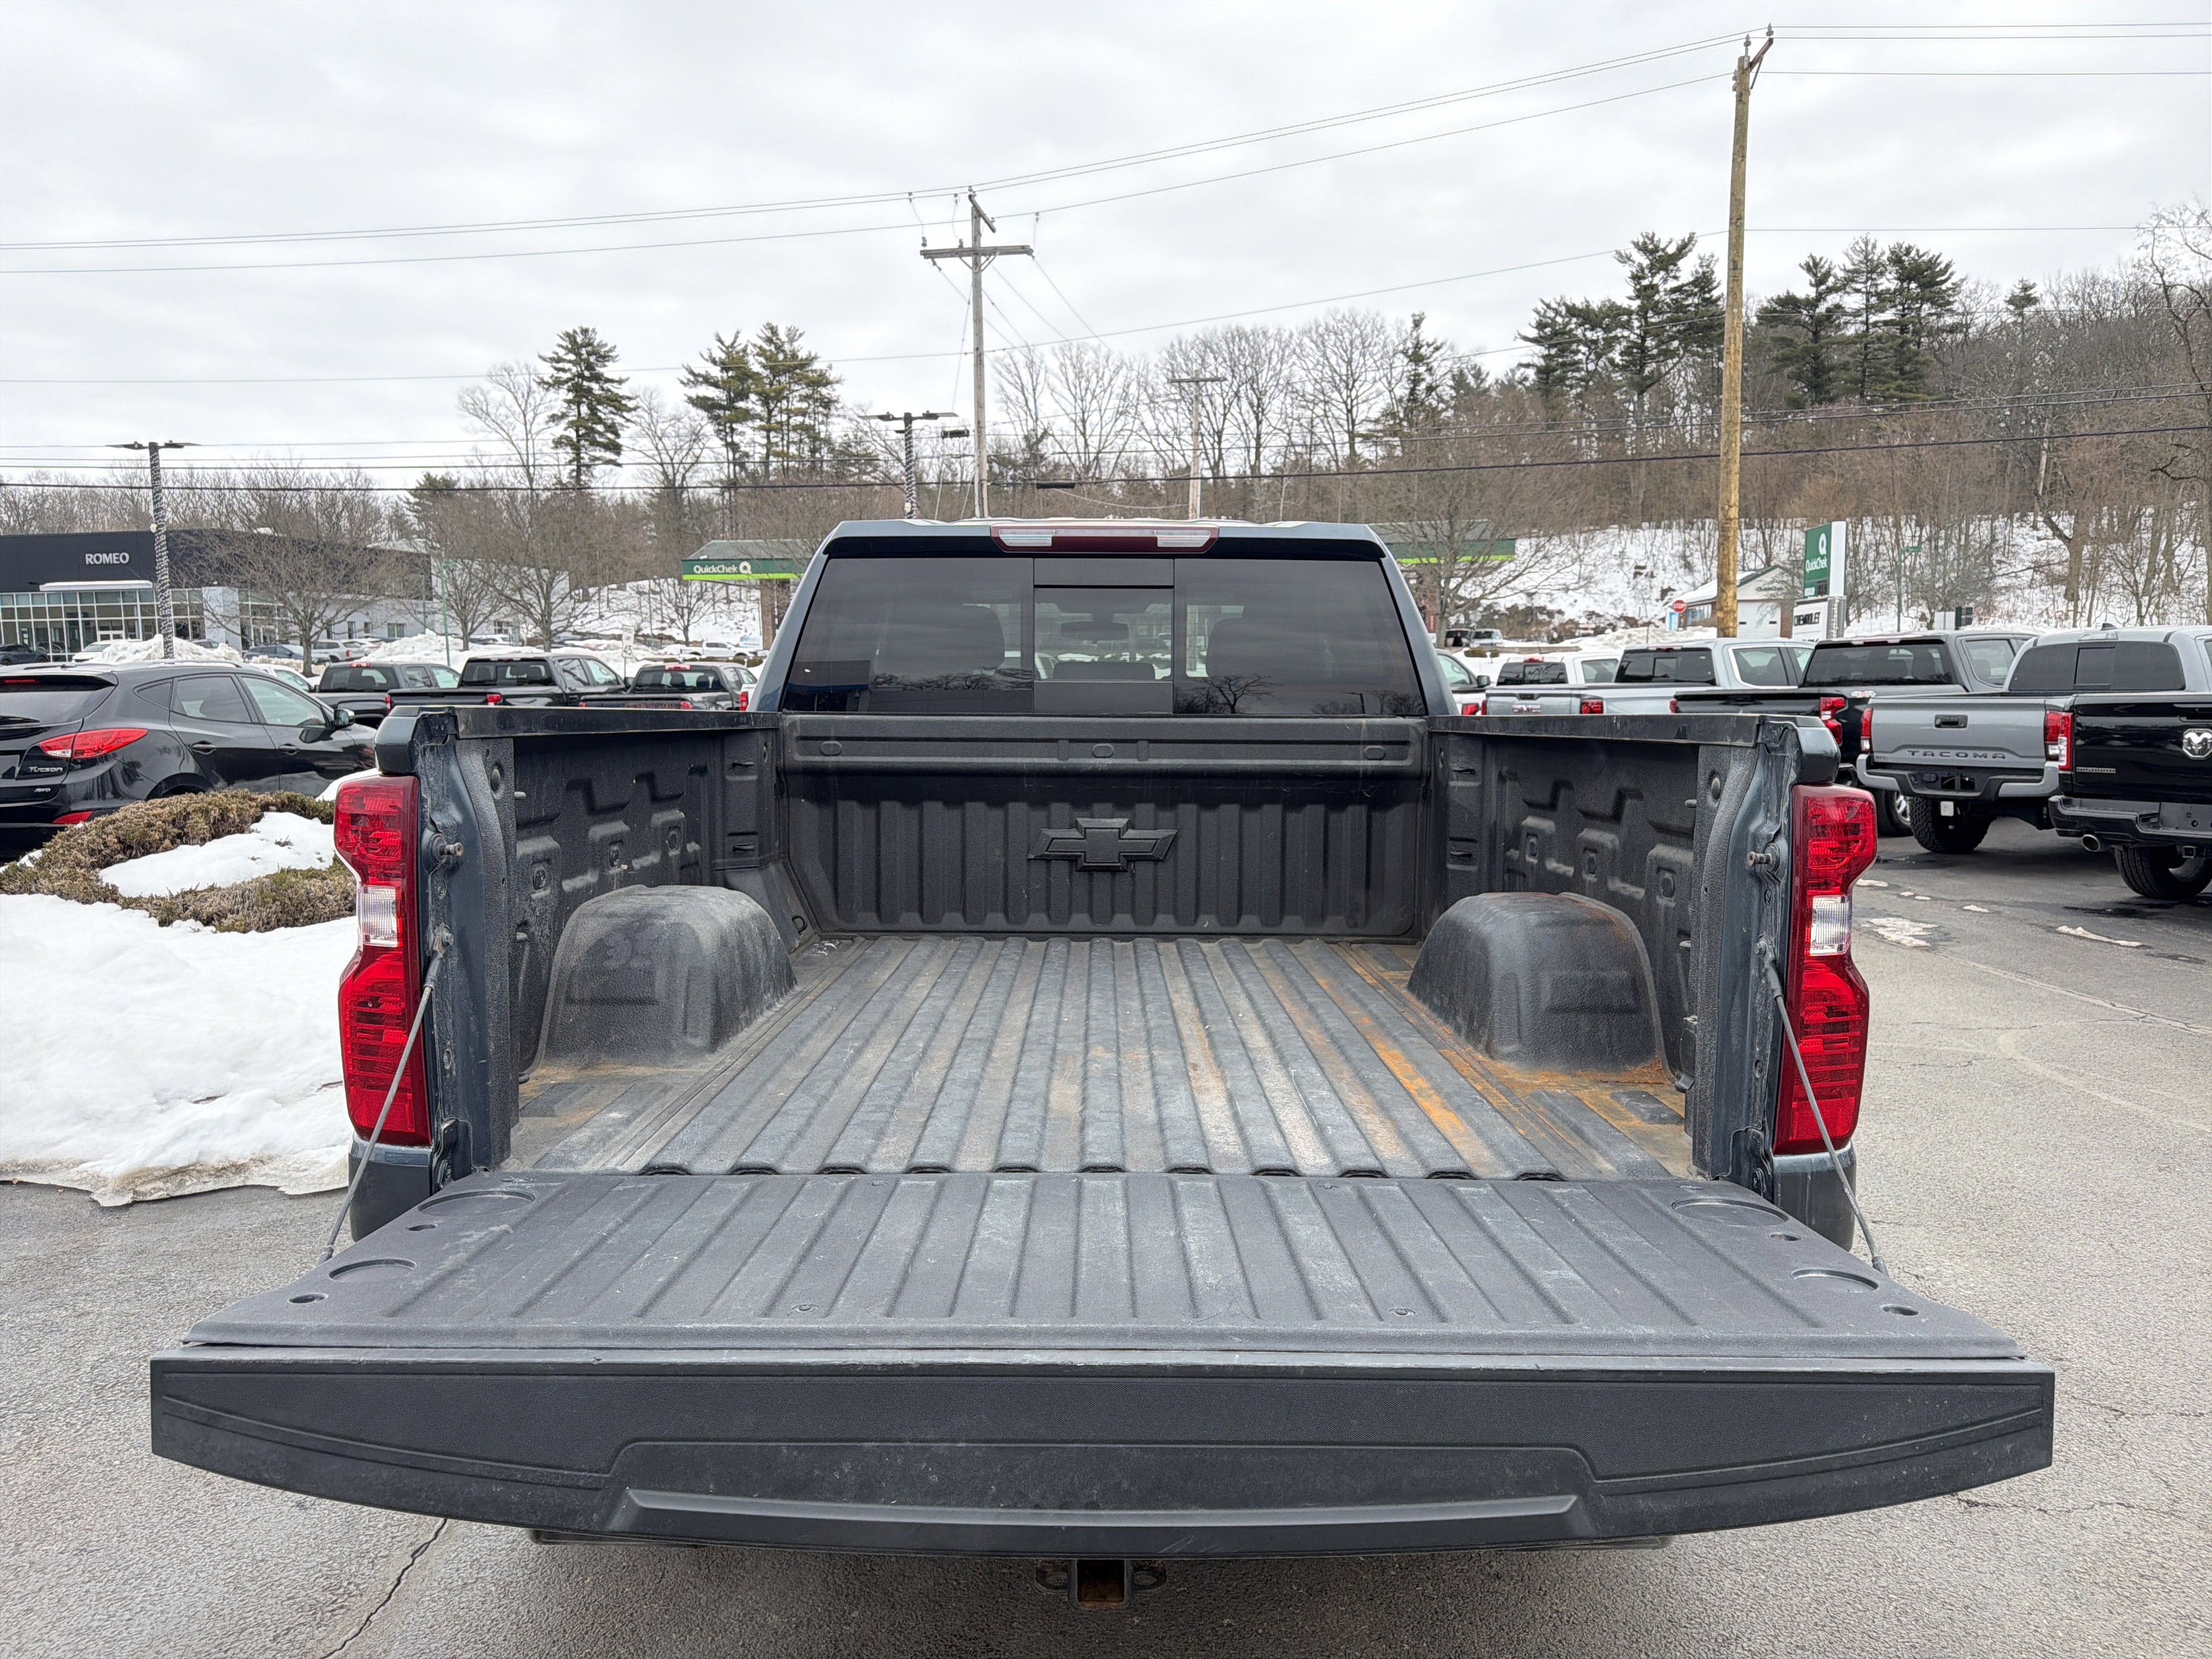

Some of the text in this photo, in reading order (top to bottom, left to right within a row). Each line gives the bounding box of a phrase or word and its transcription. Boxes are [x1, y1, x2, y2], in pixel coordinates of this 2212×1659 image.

[85, 552, 129, 565] ROMEO
[693, 565, 737, 574] QuickChek
[1805, 556, 1827, 573] QuickChek
[624, 645, 632, 656] 45
[1513, 704, 1541, 714] GMC
[1908, 750, 2006, 759] TACOMA
